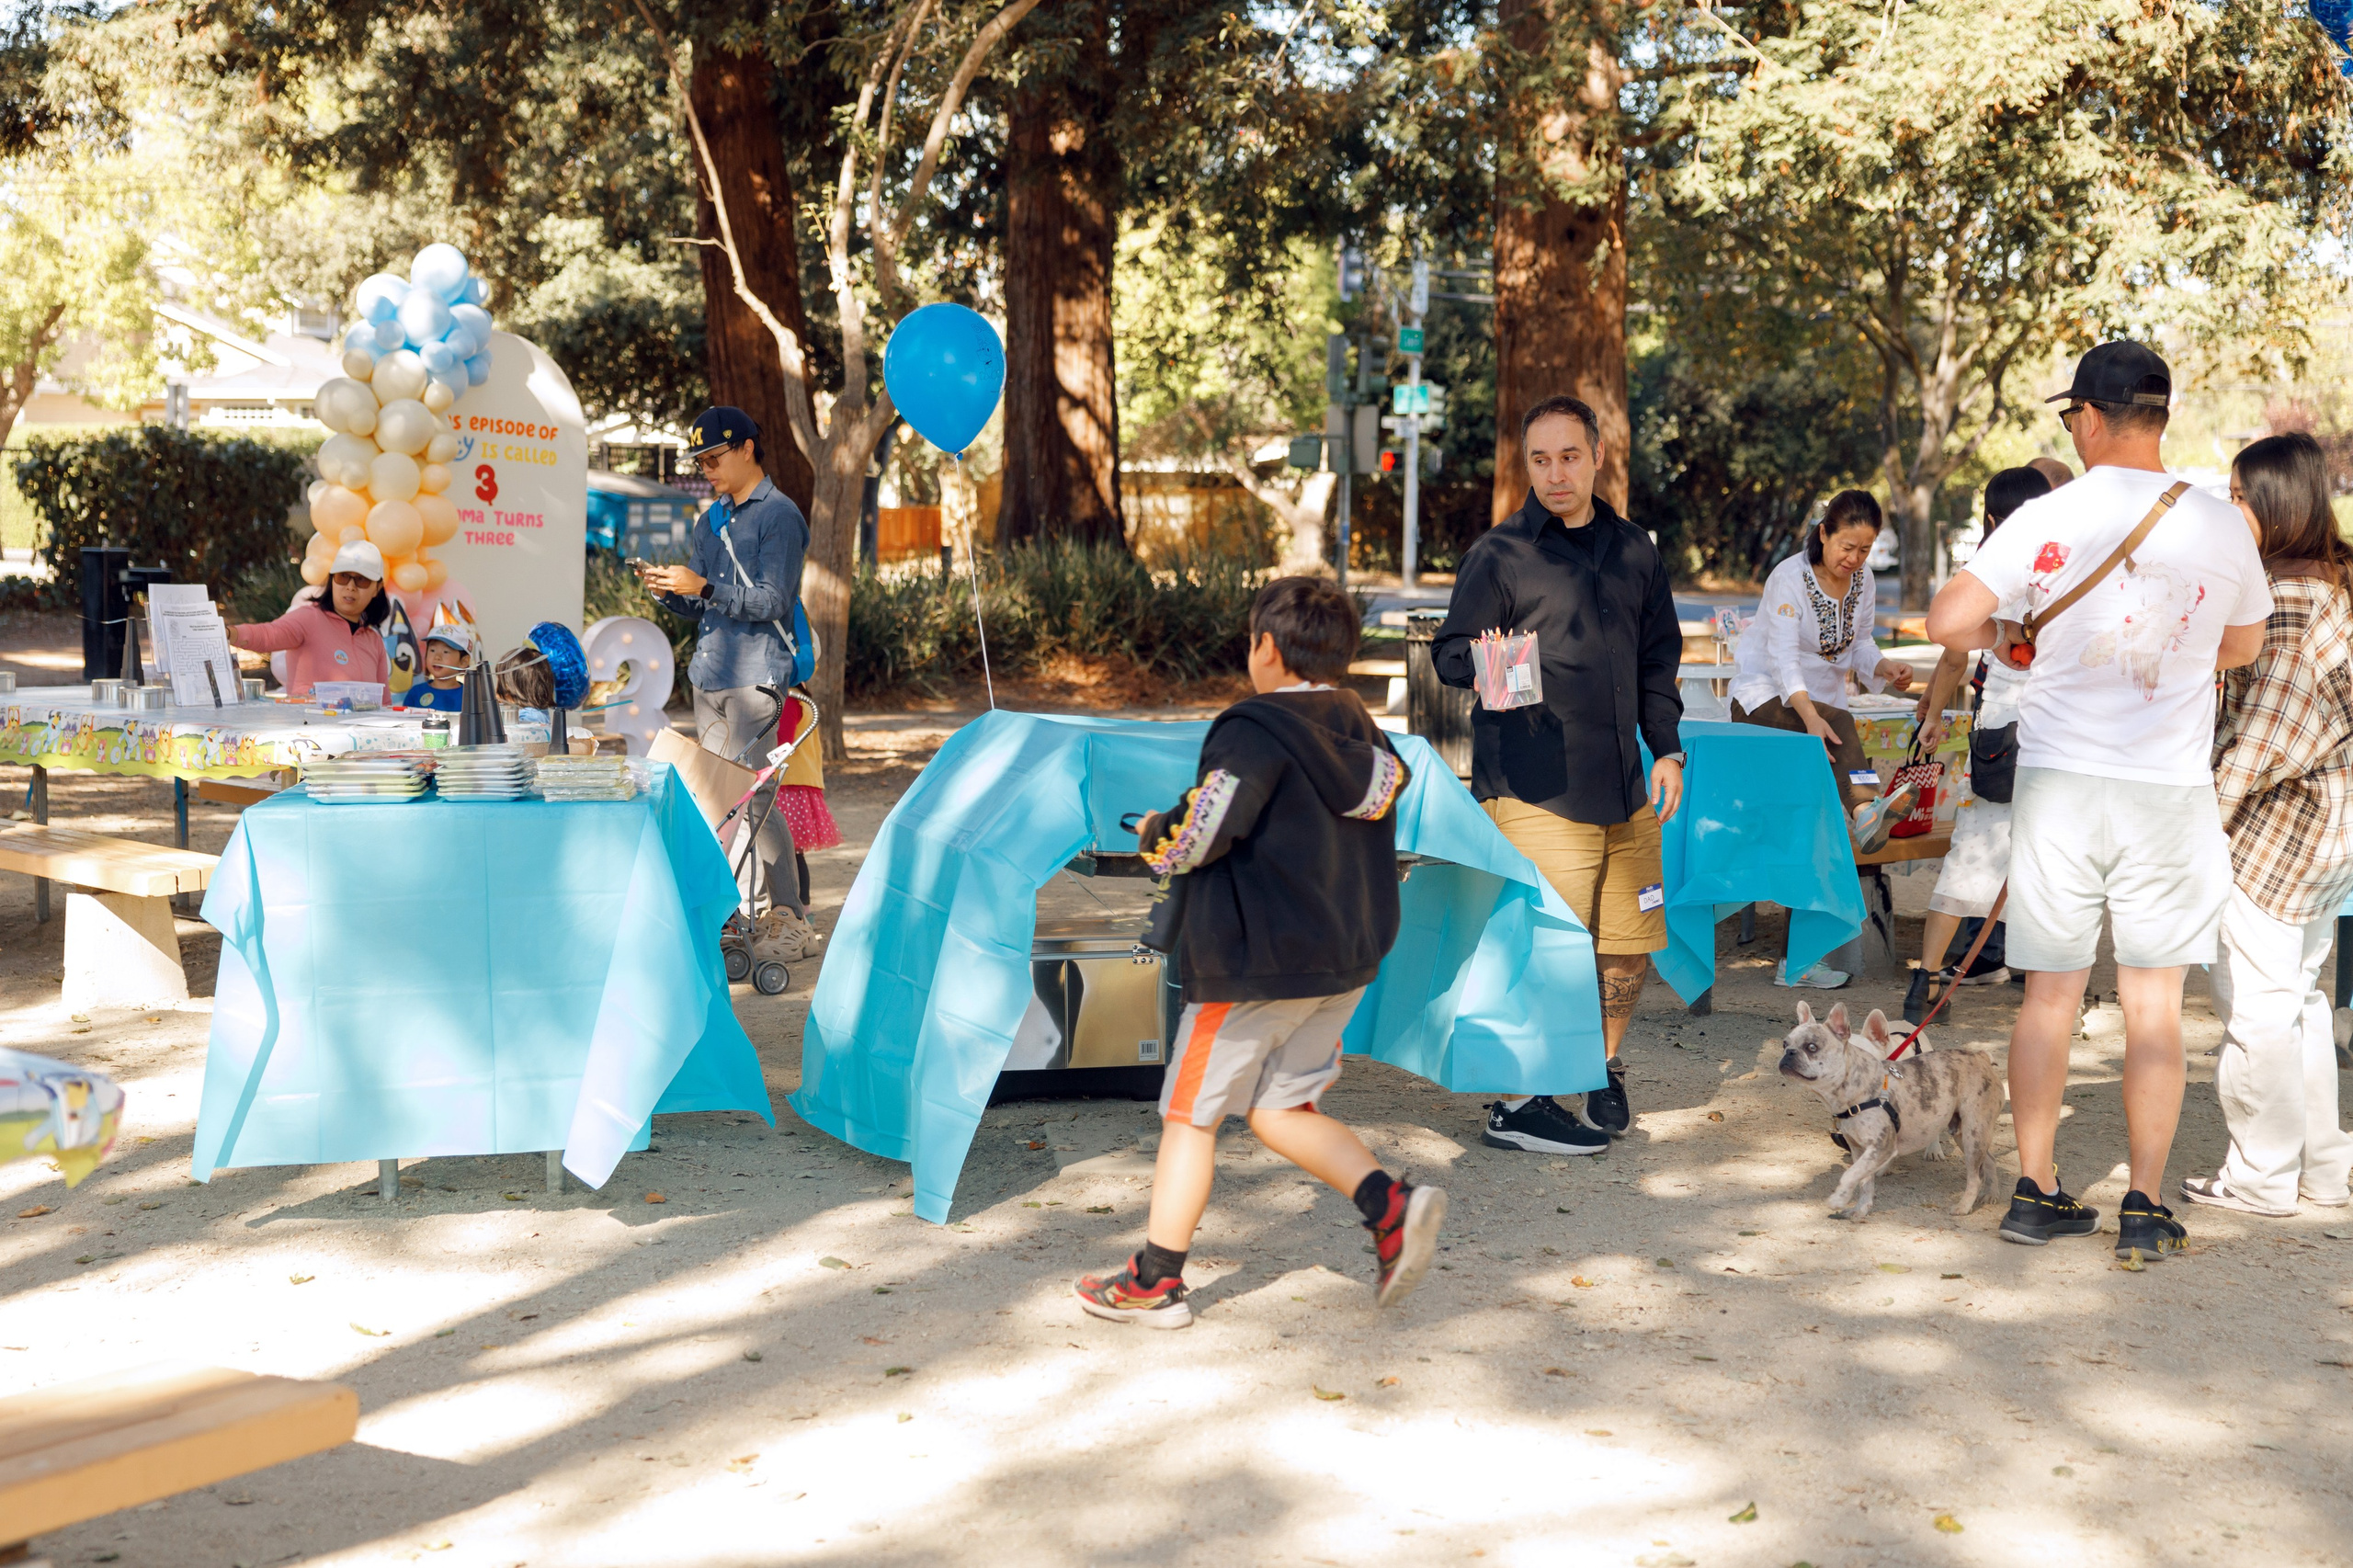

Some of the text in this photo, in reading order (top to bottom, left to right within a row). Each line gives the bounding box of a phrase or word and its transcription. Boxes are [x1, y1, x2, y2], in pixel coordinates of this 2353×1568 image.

[539, 426, 559, 441] OF
[690, 426, 704, 448] M
[481, 442, 498, 460] IS
[474, 463, 499, 506] 3
